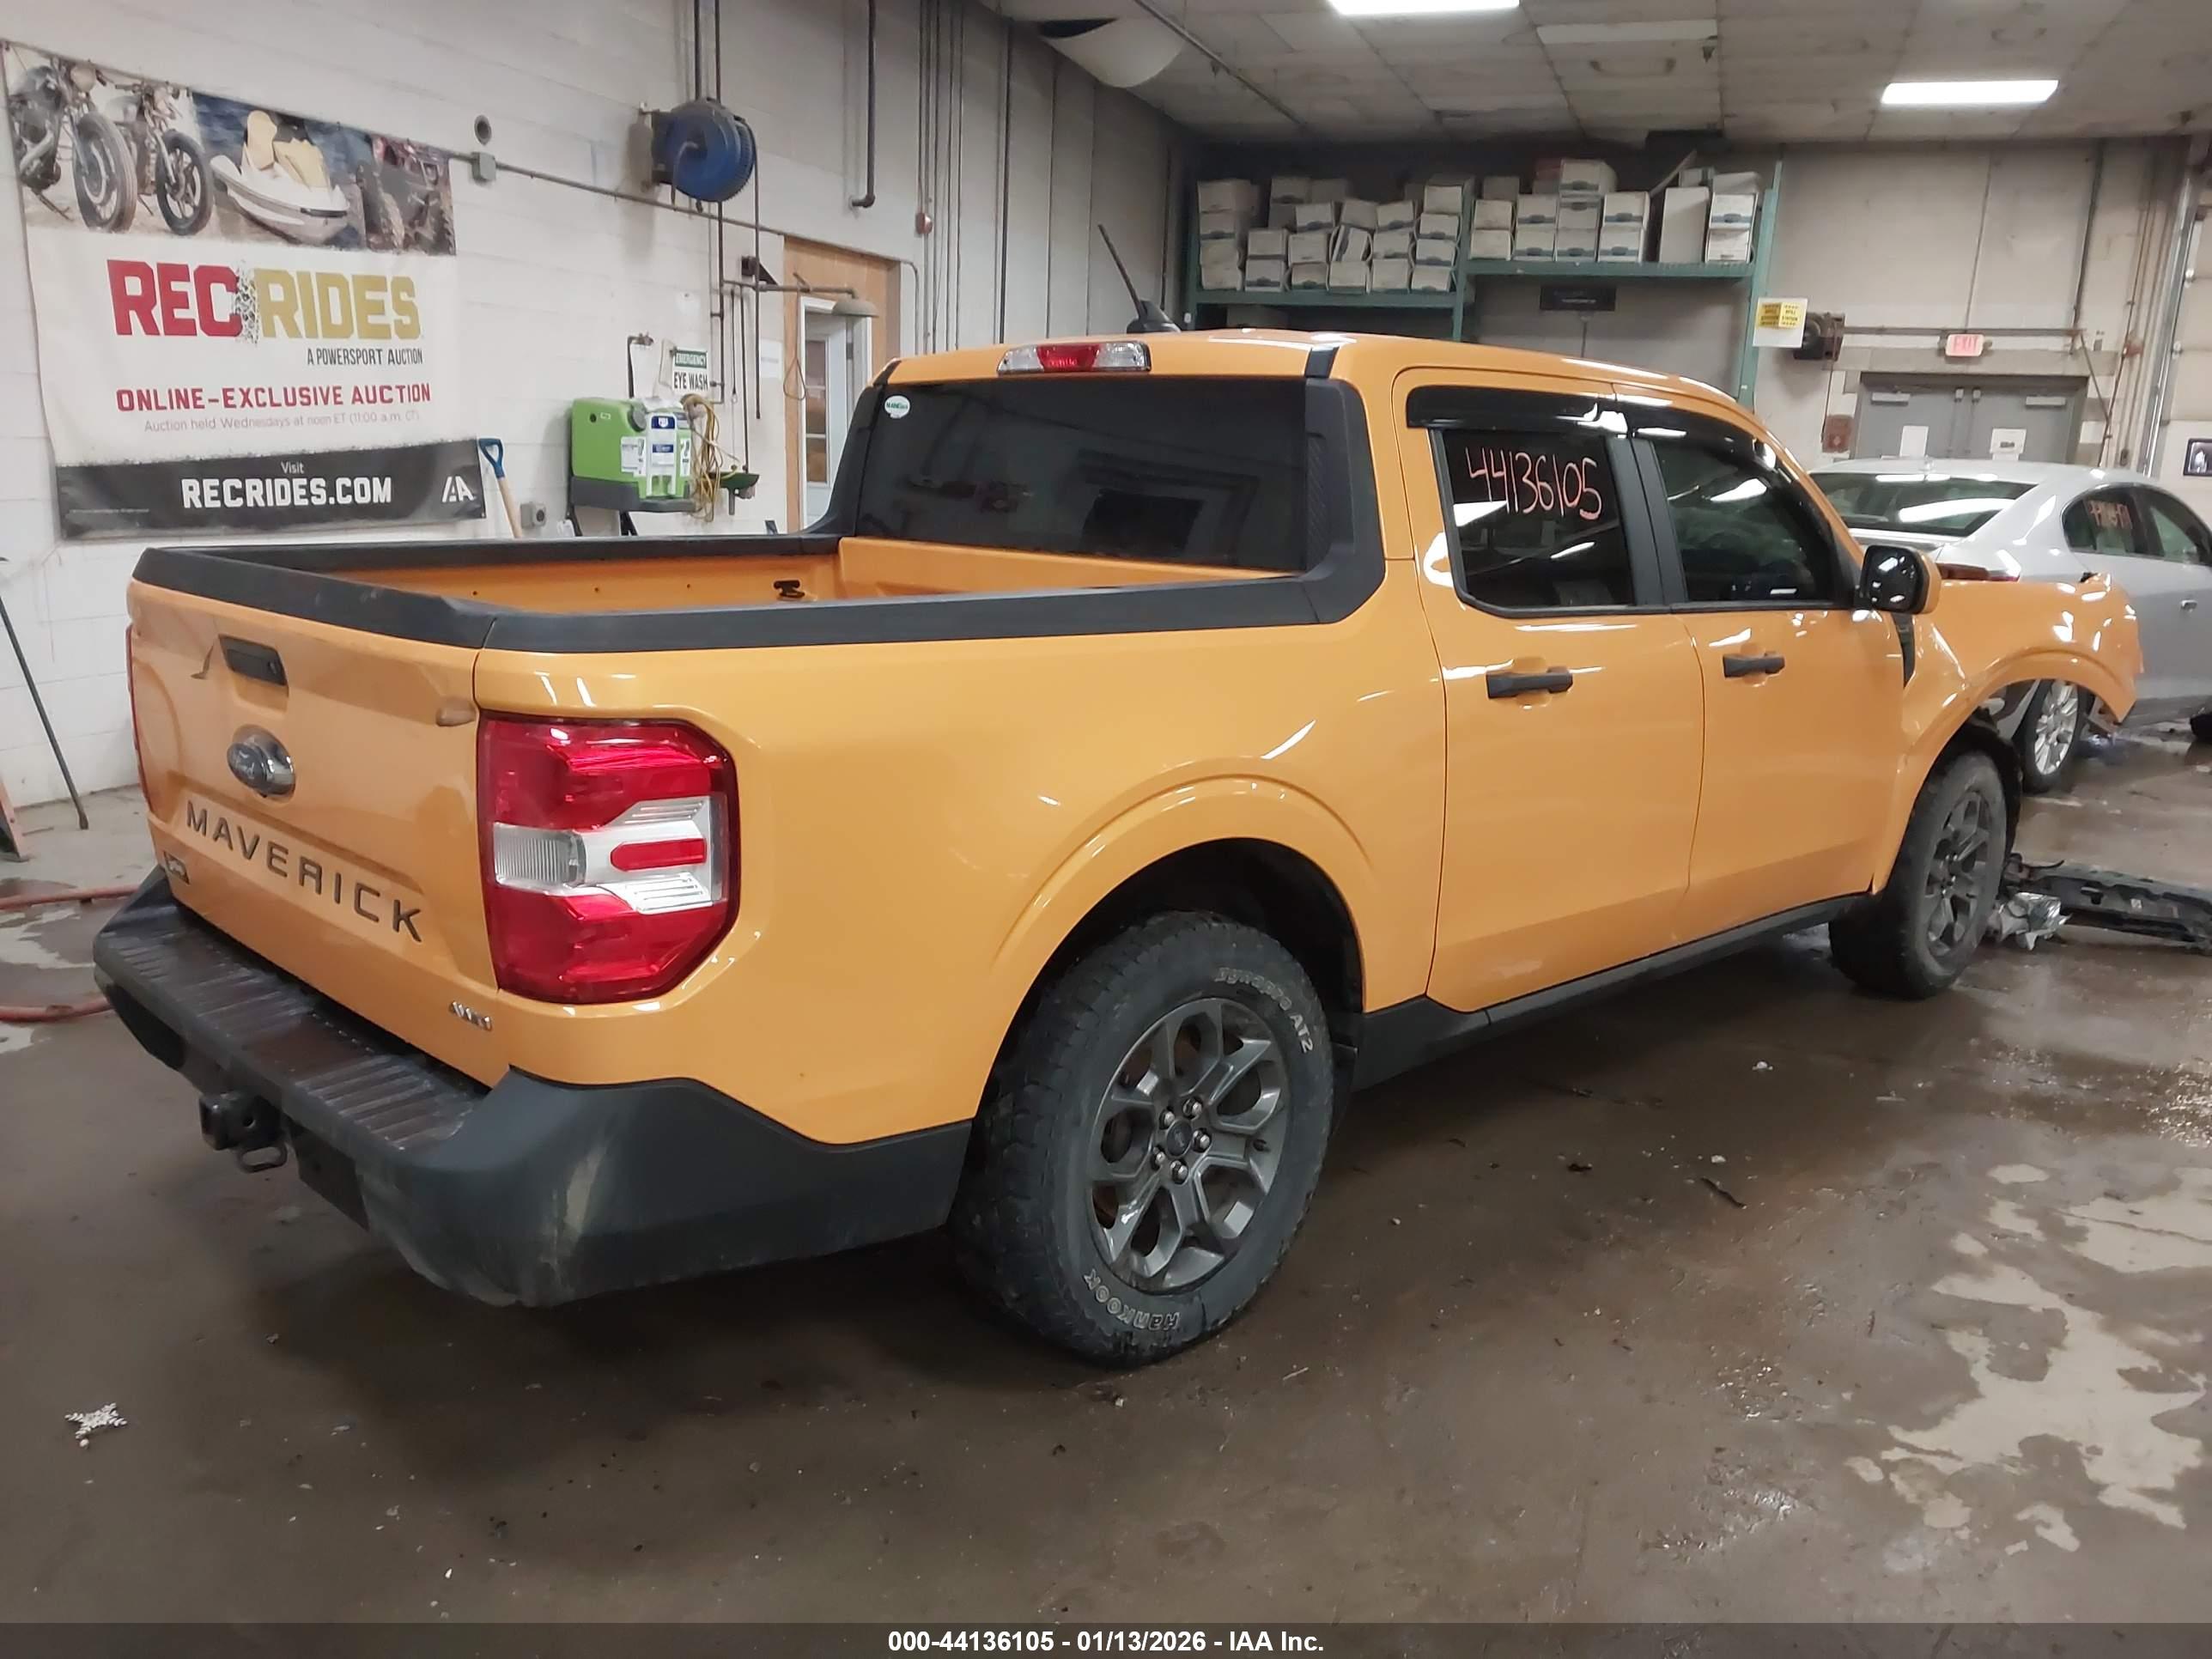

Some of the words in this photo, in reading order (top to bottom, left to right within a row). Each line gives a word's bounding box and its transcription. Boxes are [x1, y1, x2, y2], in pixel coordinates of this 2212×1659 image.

[107, 259, 243, 337] REC
[254, 268, 422, 339] RIDES
[307, 349, 314, 365] A
[317, 348, 383, 366] POWERSPORT
[387, 348, 423, 365] AUCTION
[674, 370, 687, 390] EYE
[689, 372, 708, 392] WASH
[117, 386, 343, 412] ONLINE-EXCLUSIVE
[351, 382, 431, 405] AUCTION
[144, 418, 187, 432] Auction
[191, 417, 216, 429] held
[220, 416, 290, 429] Wednesdays
[294, 416, 303, 426] at
[307, 416, 331, 427] noon
[334, 413, 345, 424] ET
[281, 460, 304, 475] Visit
[180, 476, 392, 509] RECRIDES.COM
[1465, 447, 1602, 520] 44136105
[186, 799, 422, 943] MAVERICK
[1290, 1013, 1314, 1054] AT2
